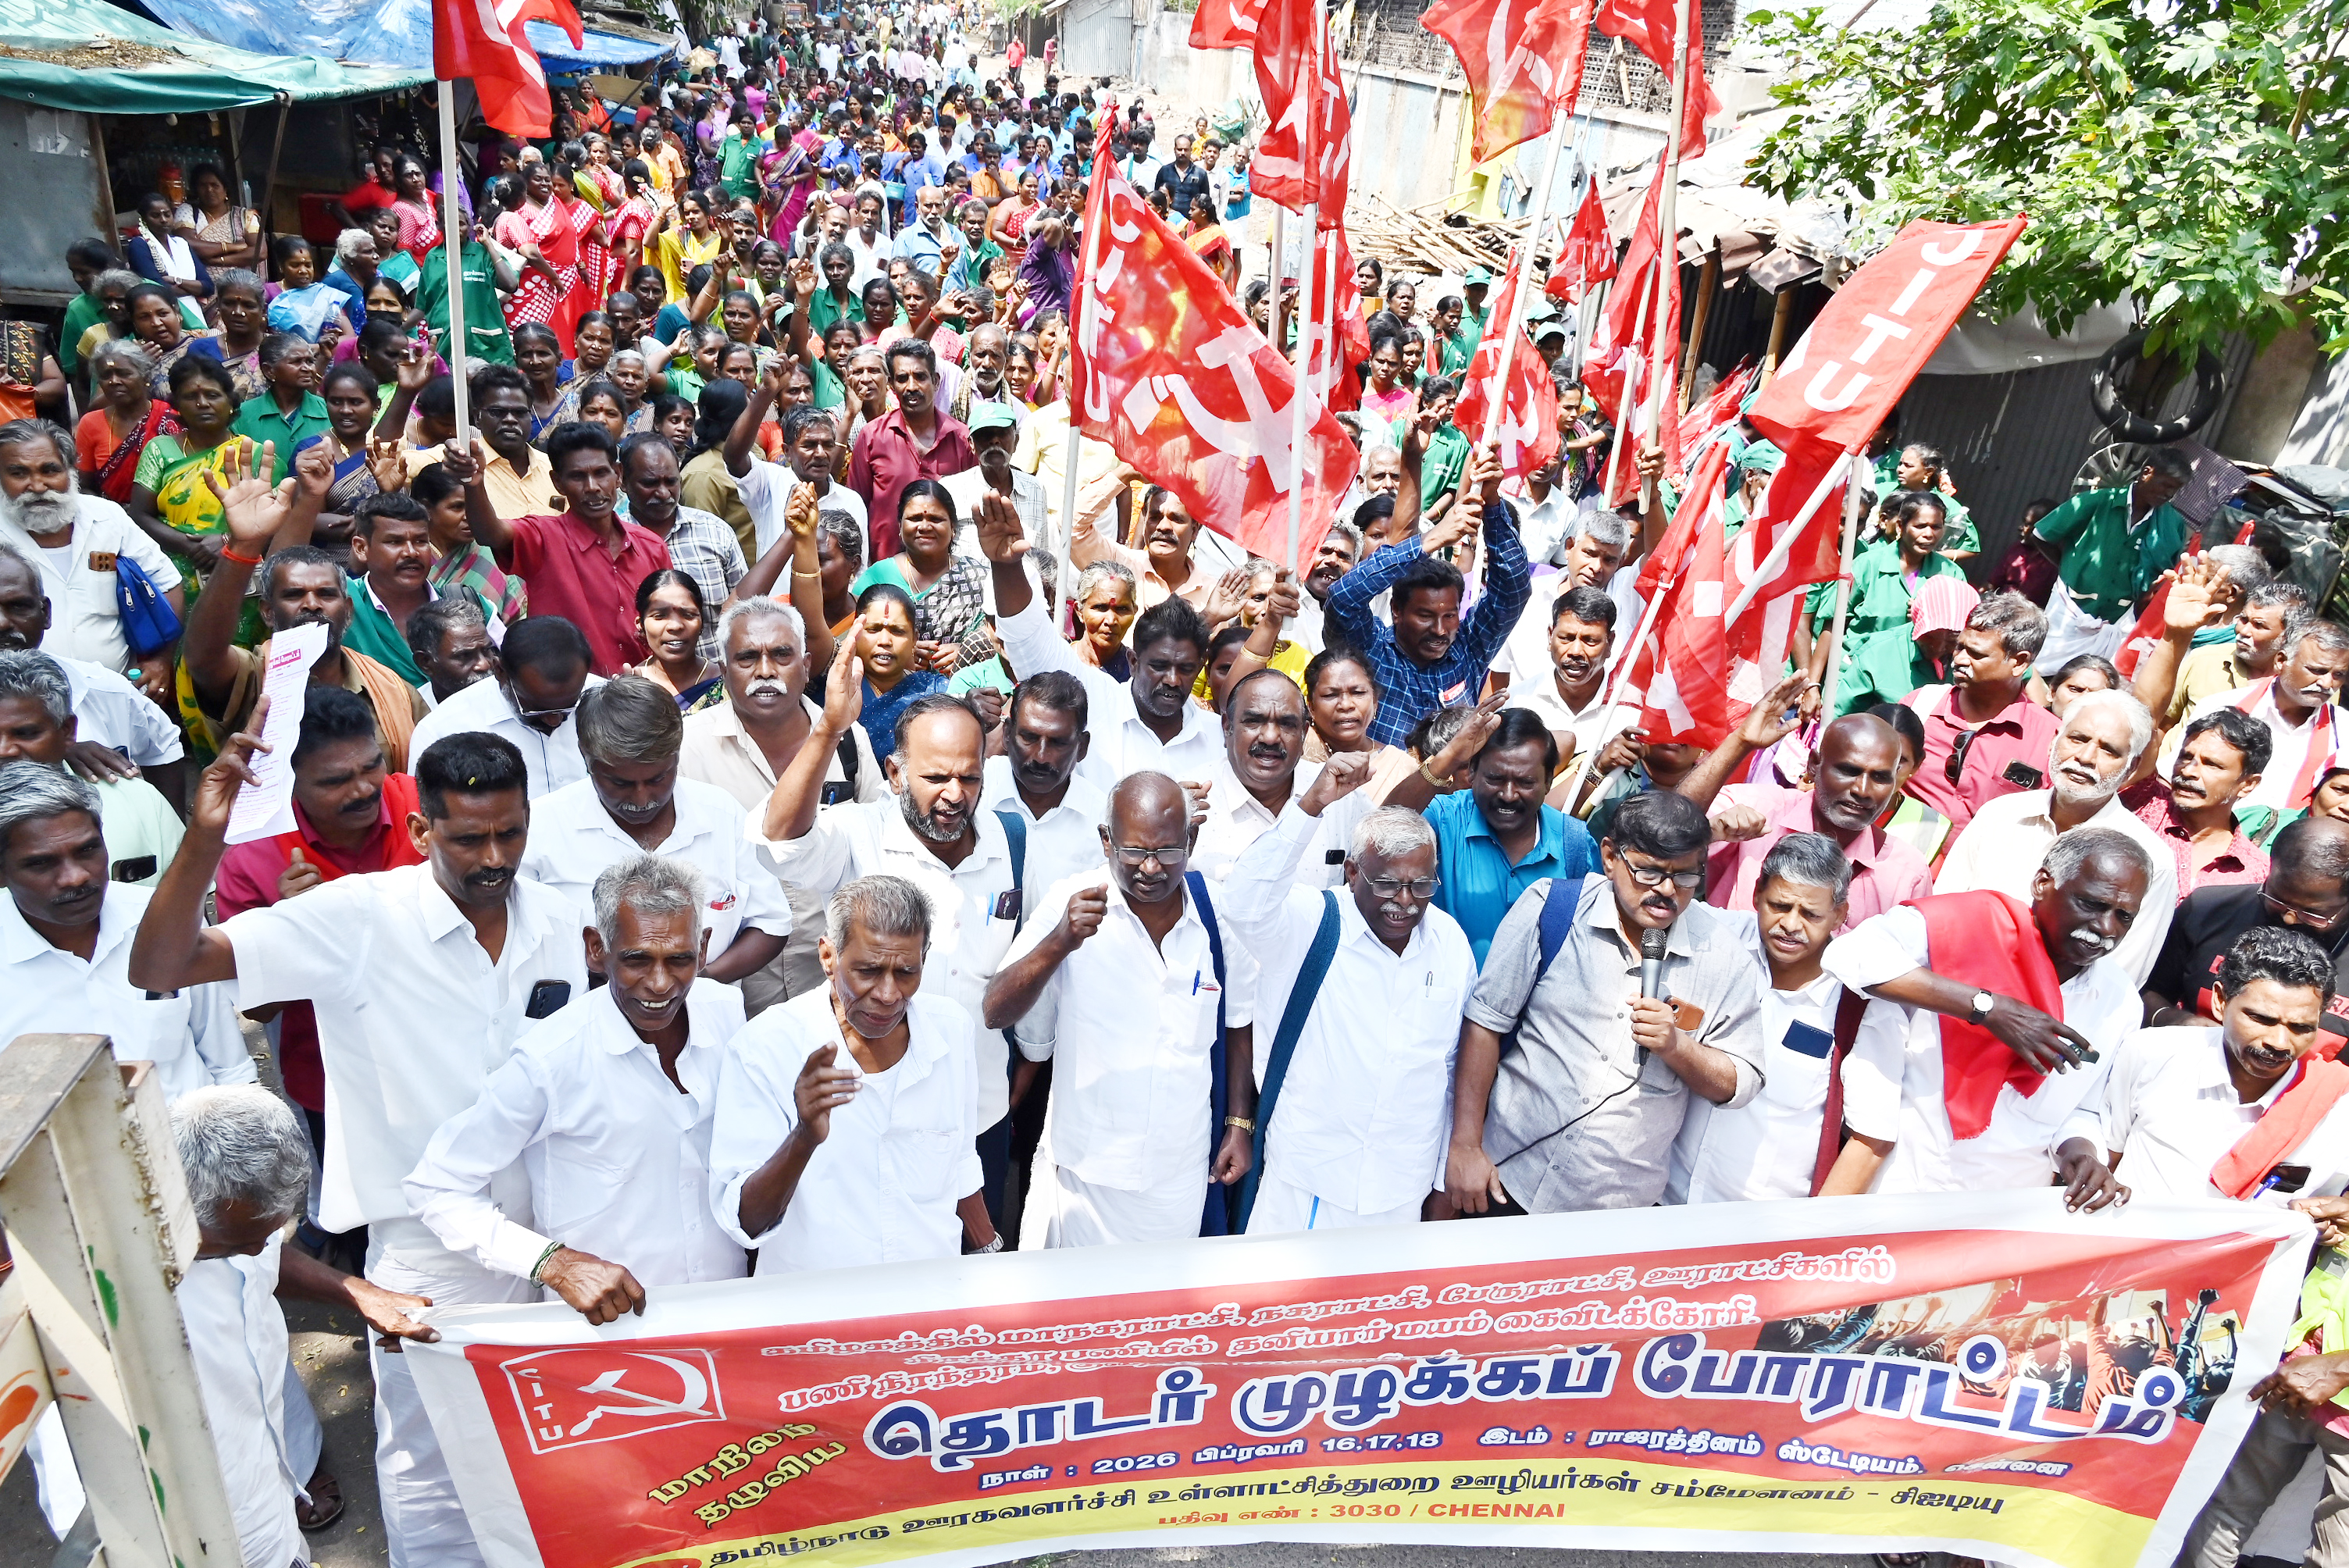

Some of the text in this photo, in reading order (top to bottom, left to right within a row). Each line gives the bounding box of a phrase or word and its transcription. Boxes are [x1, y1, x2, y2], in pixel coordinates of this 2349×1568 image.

[1640, 1245, 1896, 1288] ஊராட்சிகளில்
[1059, 1335, 1218, 1360] பணியில்
[1225, 1318, 1393, 1357] தனியார்
[1392, 1309, 1494, 1340] மயம்
[517, 1368, 564, 1441] CITU
[779, 1374, 872, 1412] பணி
[863, 1333, 2186, 1472] தொடர் முழக்கப் போராட்டம்
[647, 1424, 818, 1505] மாநிலம்
[693, 1442, 847, 1529] தழுவிய
[980, 1464, 1051, 1489] நாள்
[1093, 1452, 1179, 1474] 2026
[1194, 1438, 1306, 1463] பிப்ரவரி
[1322, 1431, 1441, 1452] 16,17,18
[1479, 1426, 1551, 1446] இடம்
[1587, 1427, 1763, 1456] ராஜரத்தினம்
[709, 1526, 889, 1568] தமிழ்நாடு
[902, 1489, 1135, 1531] ஊரகவளர்ச்சி
[1148, 1474, 1438, 1504] உள்ளாட்சித்துறை
[1450, 1466, 1641, 1495] ஊழியர்கள்
[1650, 1479, 1854, 1501] சம்மேளனம்
[1891, 1486, 2005, 1514] சிஐடியு
[1159, 1512, 1228, 1526] பதிவு
[1239, 1506, 1301, 1520] எண்
[1329, 1504, 1401, 1517] 3030
[1435, 1503, 1565, 1517] CHENNAI
